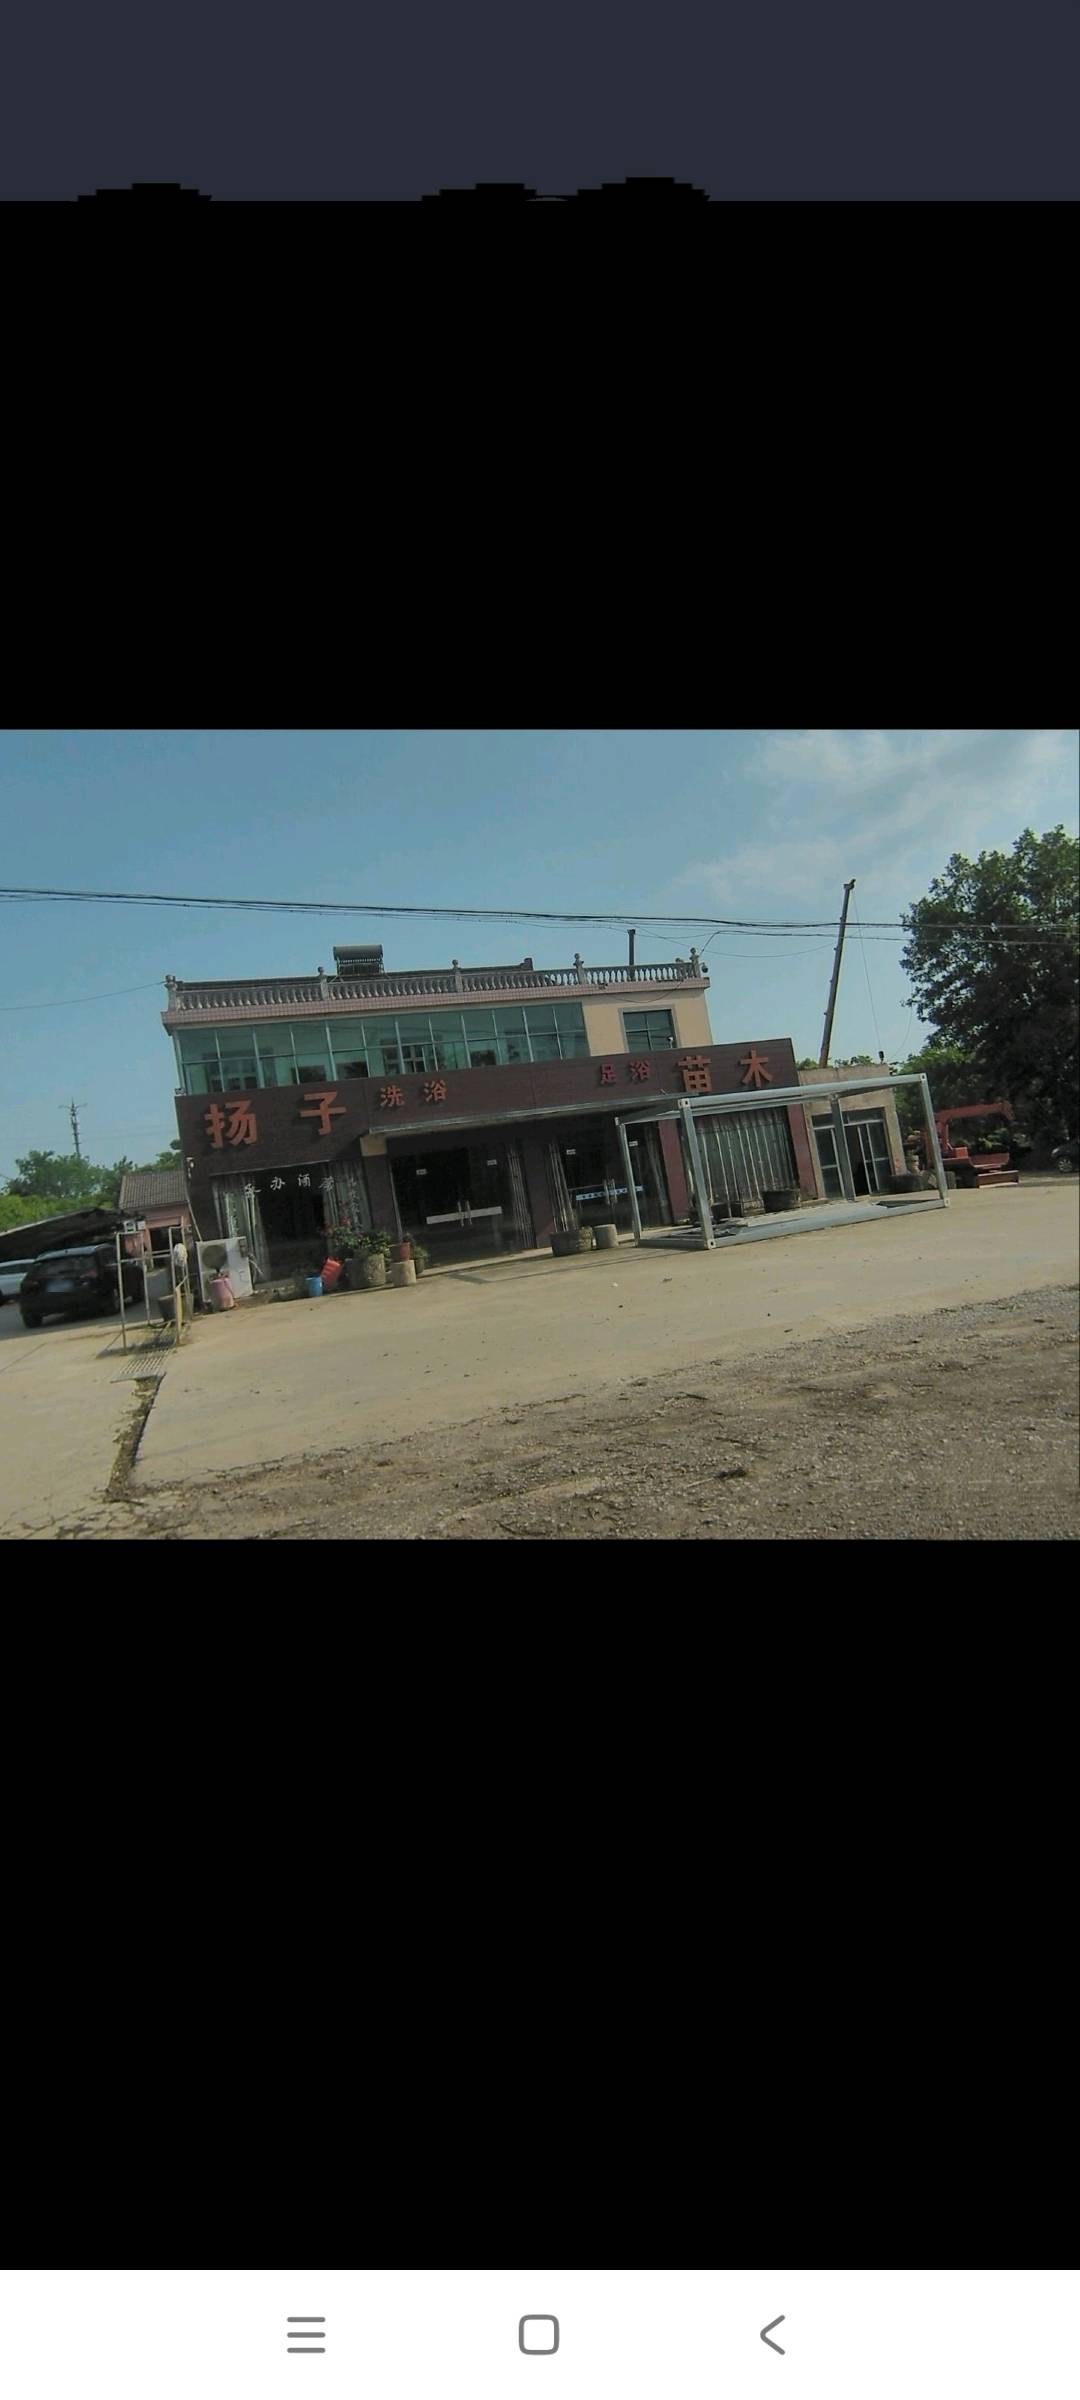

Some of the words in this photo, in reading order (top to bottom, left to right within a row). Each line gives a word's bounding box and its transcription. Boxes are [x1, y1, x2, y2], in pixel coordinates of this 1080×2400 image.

[600, 1060, 650, 1085] 足浴
[678, 1050, 774, 1092] 苗木
[380, 1080, 447, 1107] 洗浴
[204, 1090, 347, 1148] 扬子
